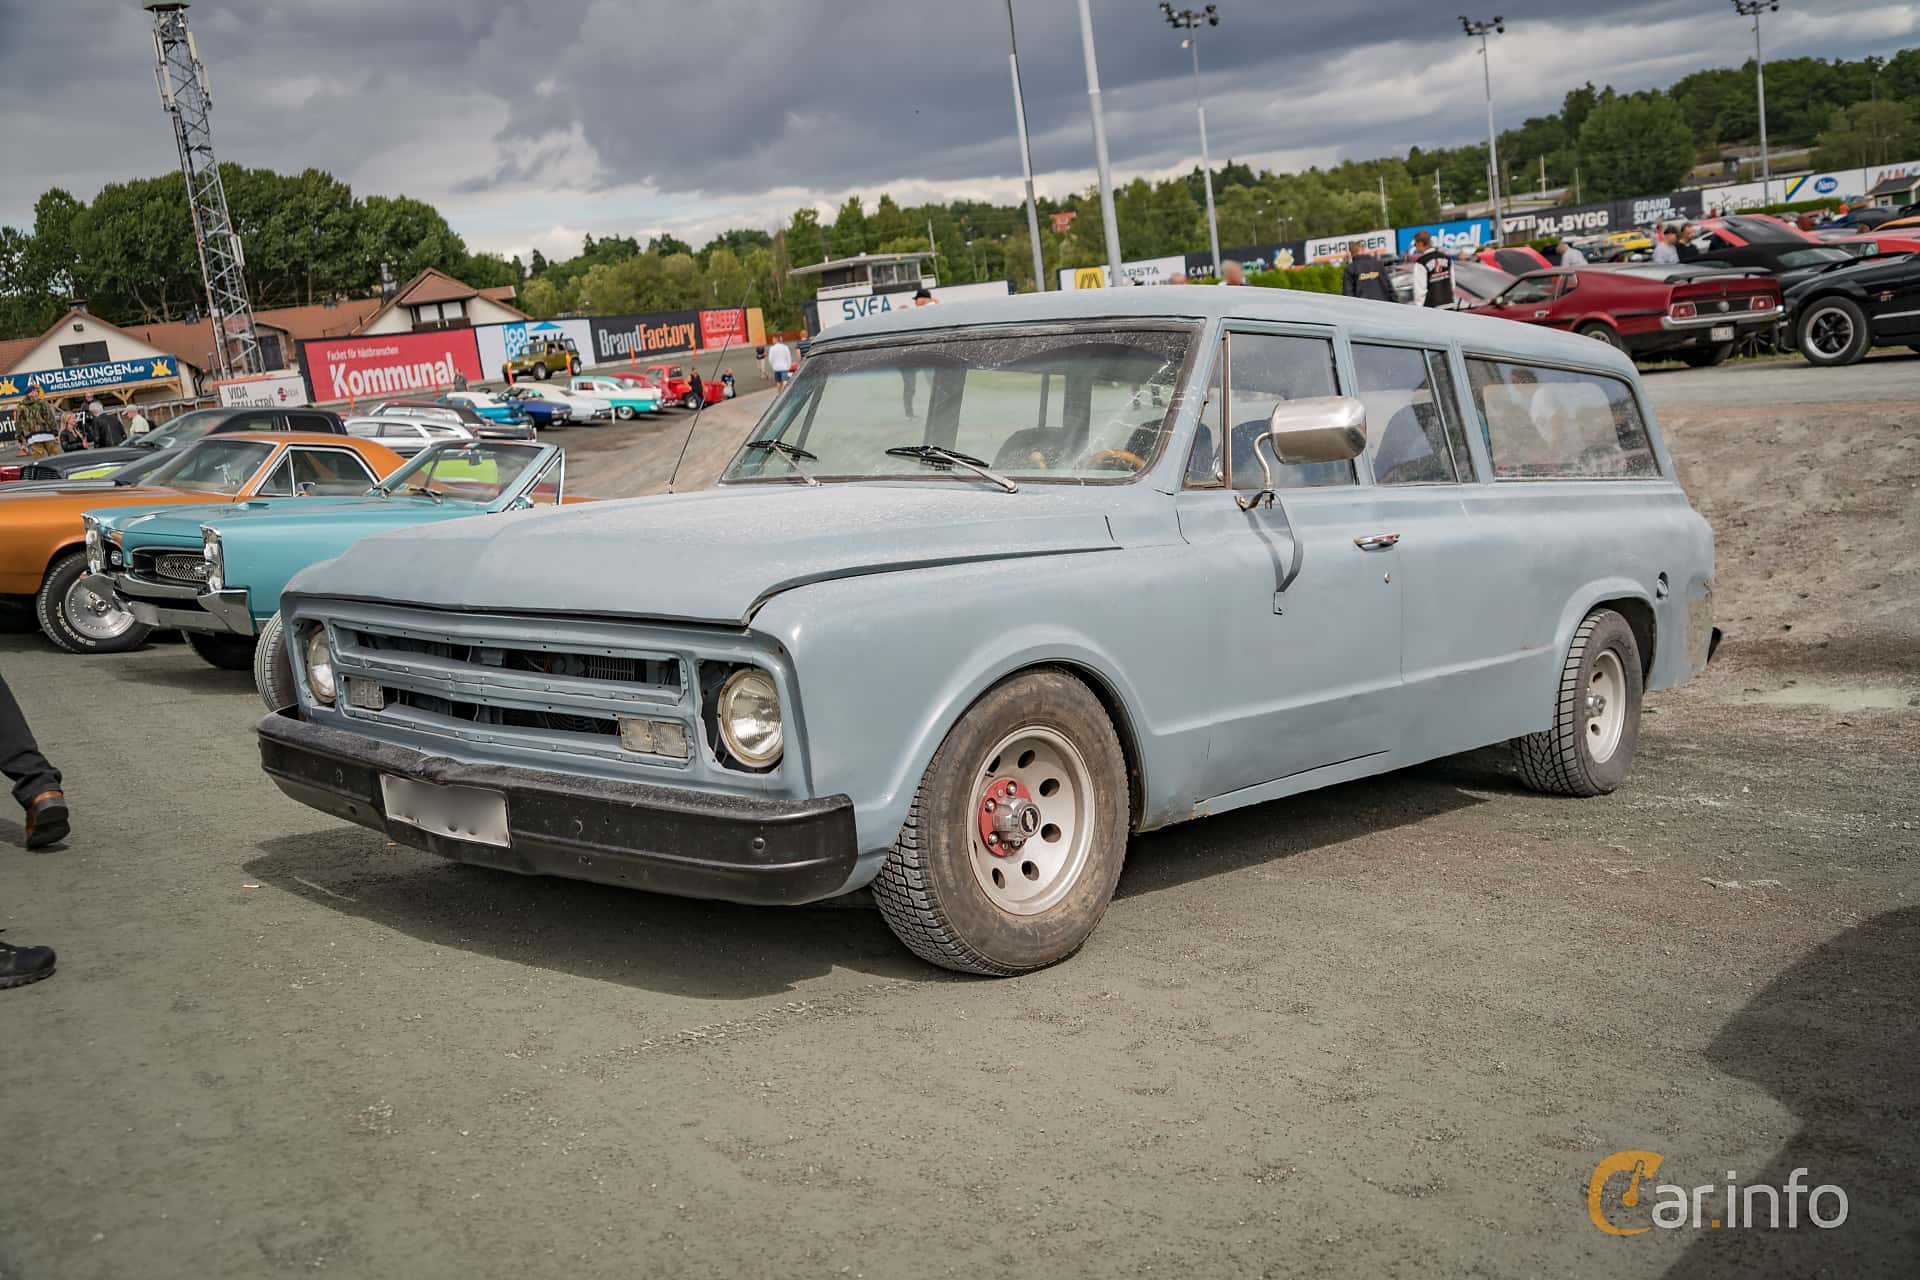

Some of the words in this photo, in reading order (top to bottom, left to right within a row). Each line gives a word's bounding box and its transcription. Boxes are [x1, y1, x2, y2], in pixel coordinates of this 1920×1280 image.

[1635, 198, 1671, 212] GRAND
[1537, 210, 1609, 235] XL-BYGG
[842, 296, 891, 320] SVEA
[598, 322, 696, 357] BrandFactory
[329, 352, 456, 398] Kommunal
[228, 386, 248, 400] VIDA
